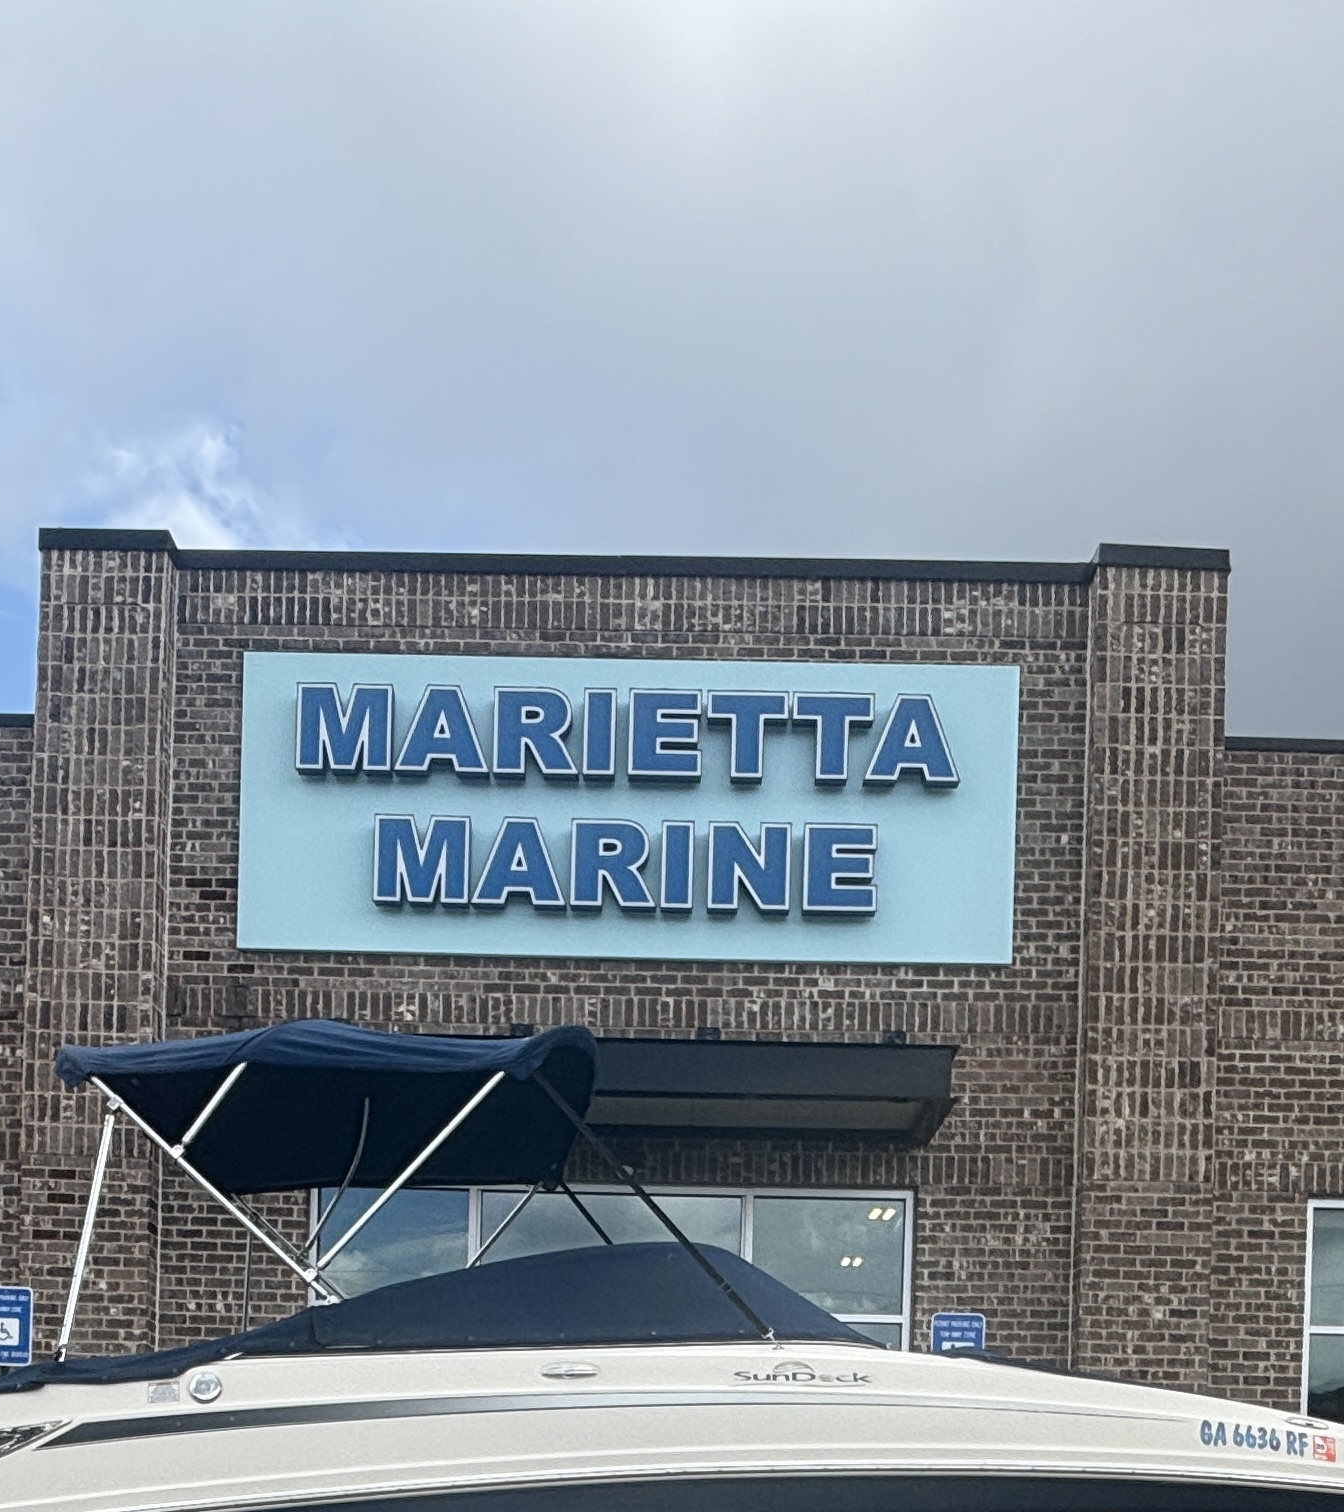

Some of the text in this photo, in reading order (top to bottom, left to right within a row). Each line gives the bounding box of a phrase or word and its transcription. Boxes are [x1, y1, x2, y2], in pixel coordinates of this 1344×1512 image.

[295, 682, 960, 788] MARIETTA
[372, 813, 878, 915] MARINE
[733, 1371, 872, 1384] SunDeck
[1200, 1419, 1227, 1447] GA
[1233, 1423, 1281, 1452] 6636
[1286, 1430, 1309, 1457] RF
